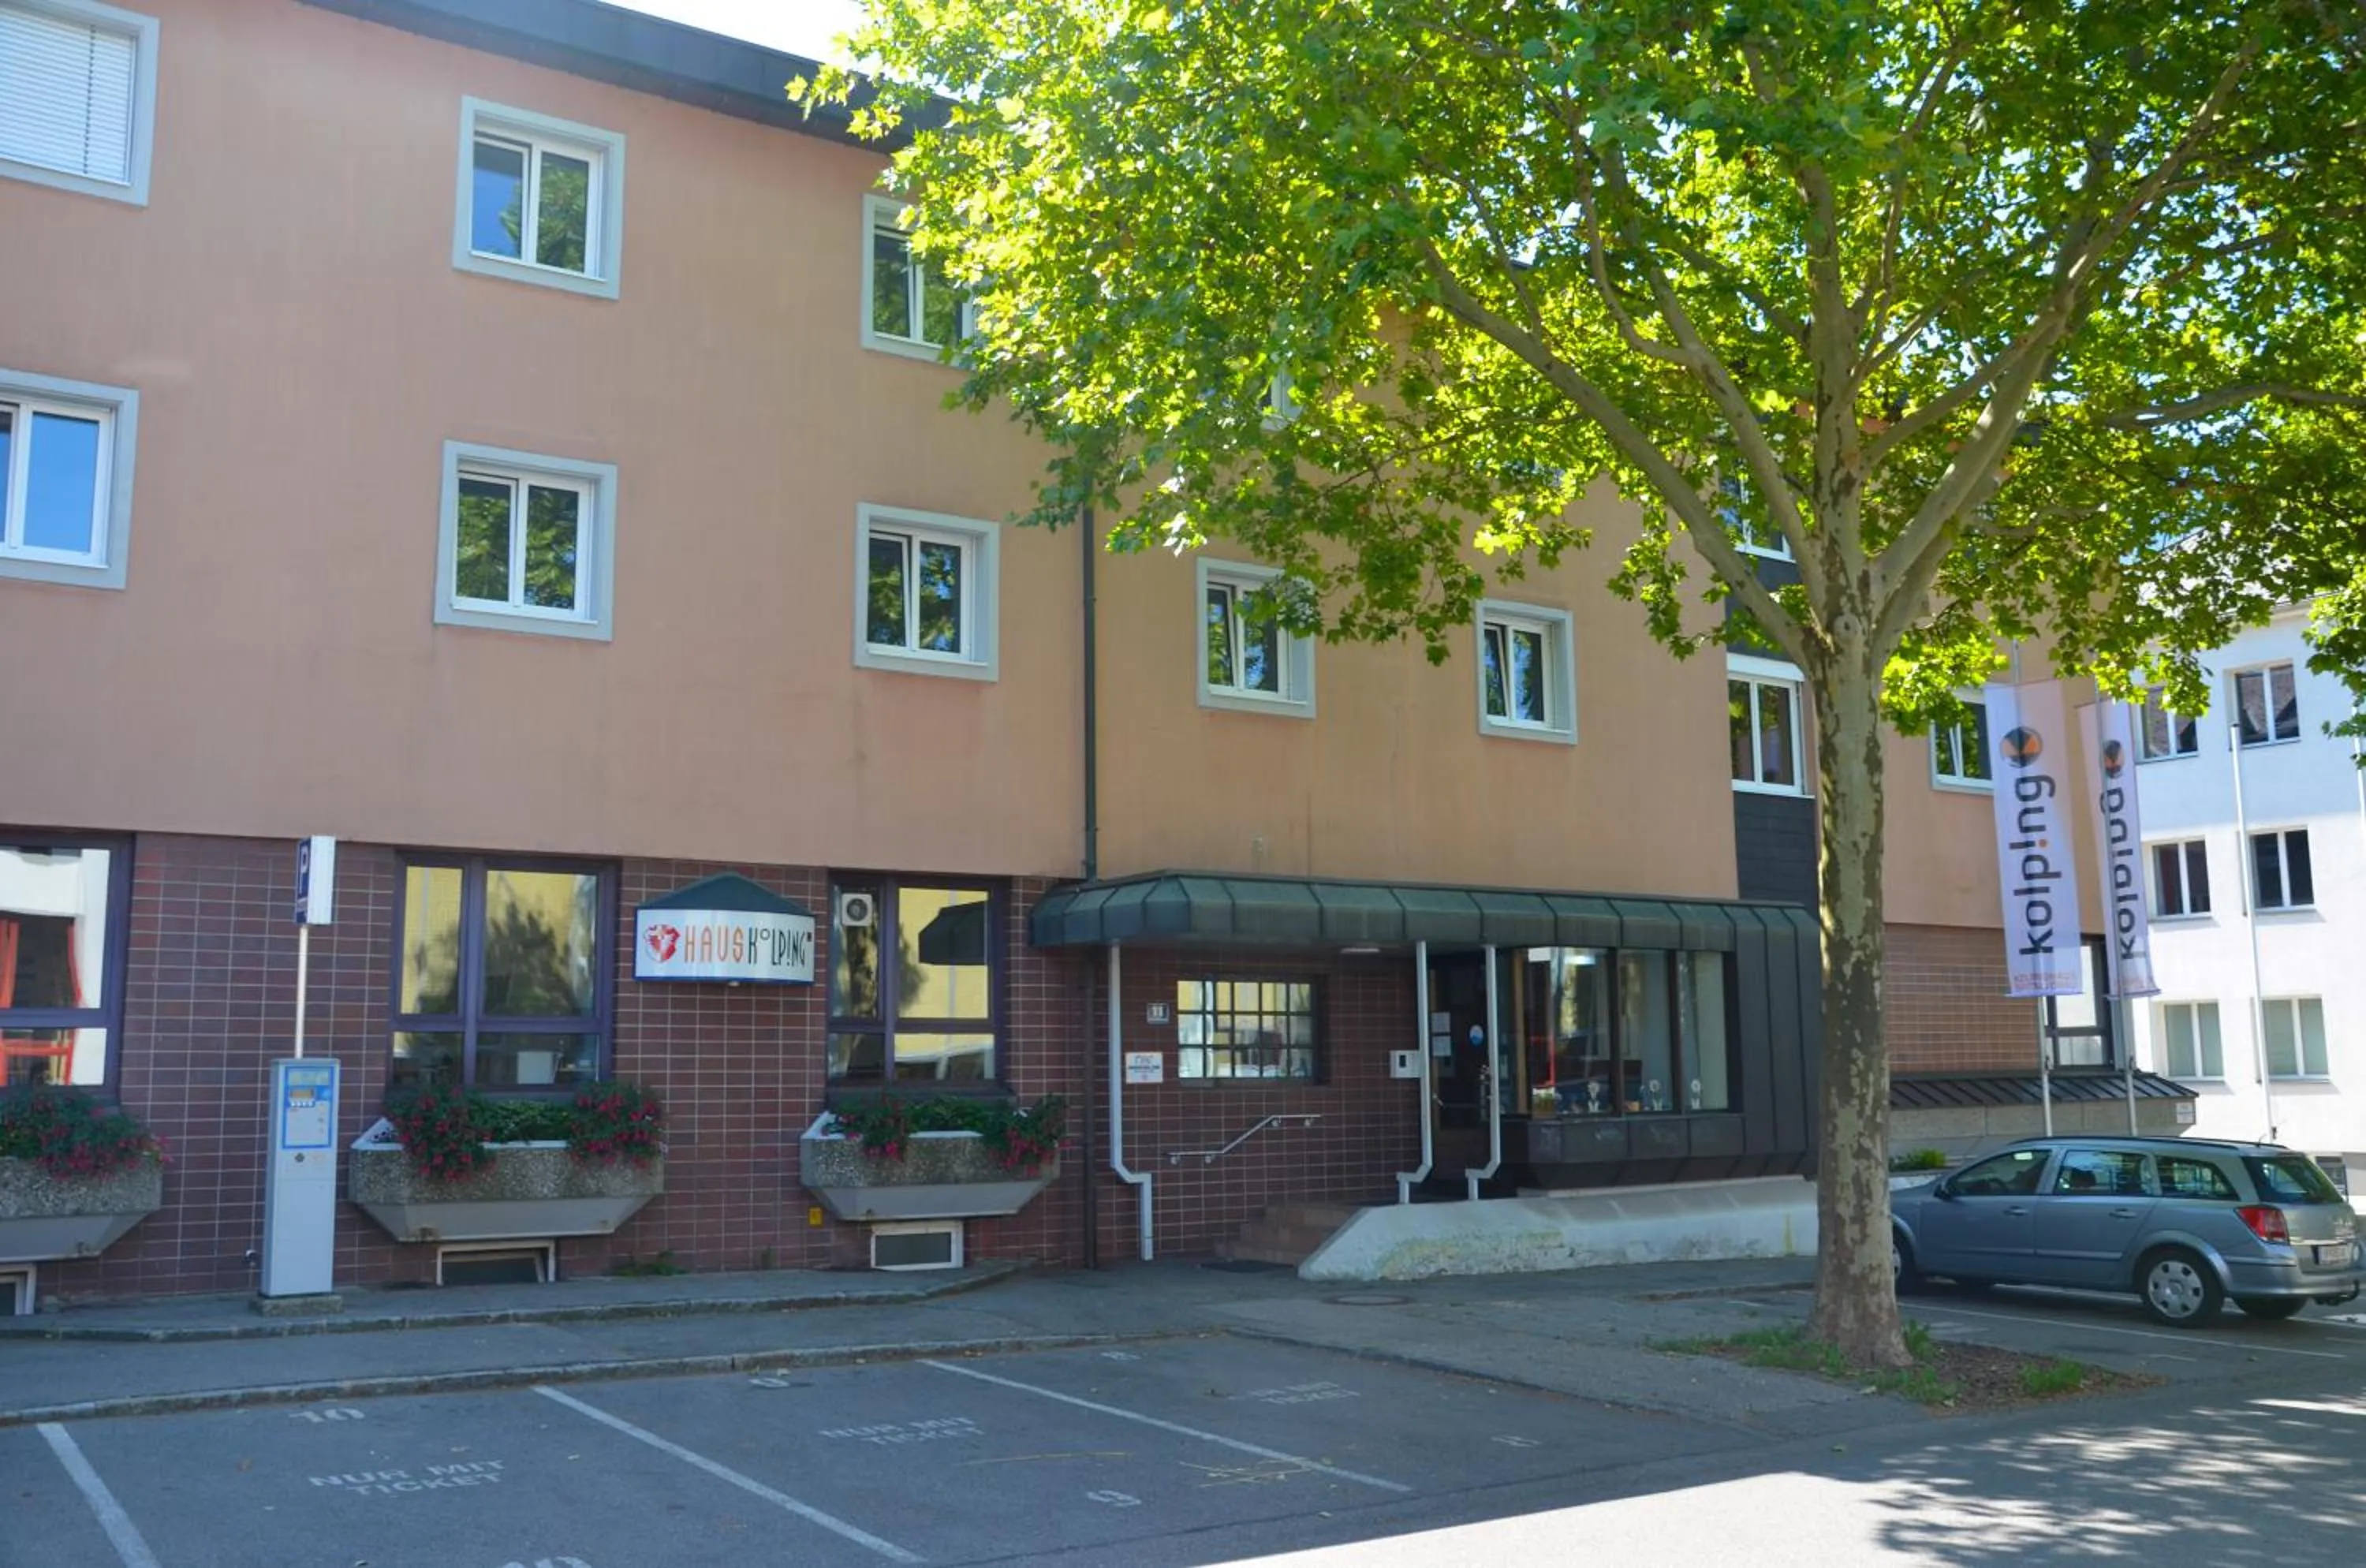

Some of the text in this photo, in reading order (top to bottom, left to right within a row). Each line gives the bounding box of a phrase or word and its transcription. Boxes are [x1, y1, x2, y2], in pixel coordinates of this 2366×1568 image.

[300, 846, 308, 894] P
[684, 925, 744, 963] HAUS
[289, 1408, 365, 1423] 10
[308, 1459, 505, 1486] NUR MIT
[346, 1473, 502, 1495] TICKET
